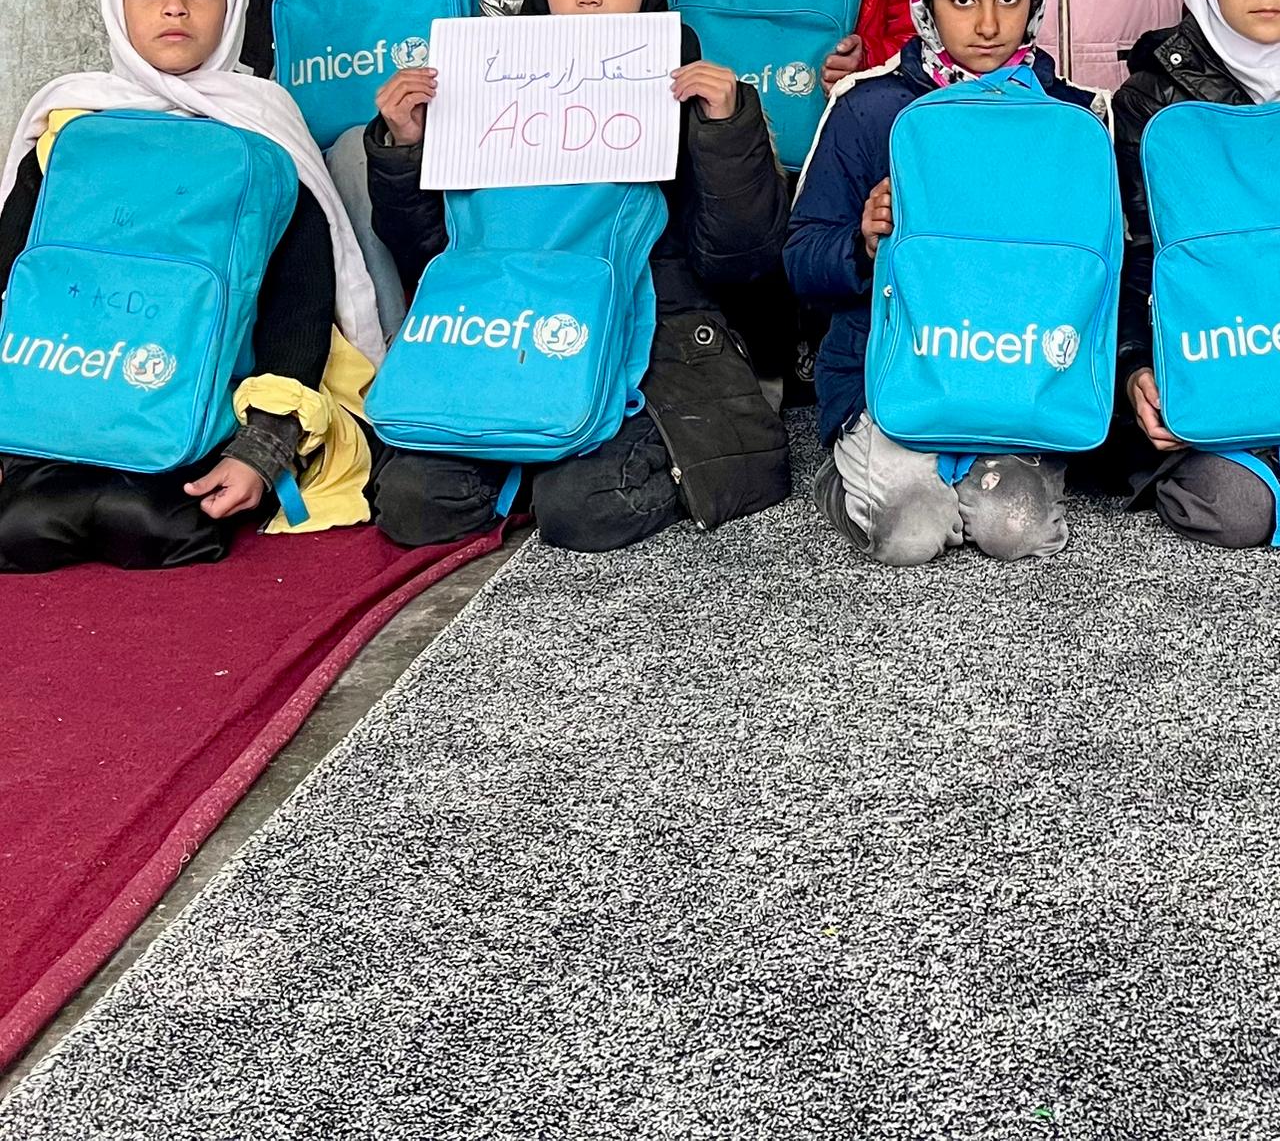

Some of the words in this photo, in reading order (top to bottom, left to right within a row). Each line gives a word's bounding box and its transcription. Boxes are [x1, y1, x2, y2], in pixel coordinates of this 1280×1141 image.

[289, 38, 387, 88] unicef
[548, 57, 576, 90] از
[557, 43, 669, 96] تشکر
[478, 100, 643, 152] ACDO
[403, 307, 535, 351] unicef
[911, 317, 1039, 365] unicef
[1, 332, 126, 380] unicef
